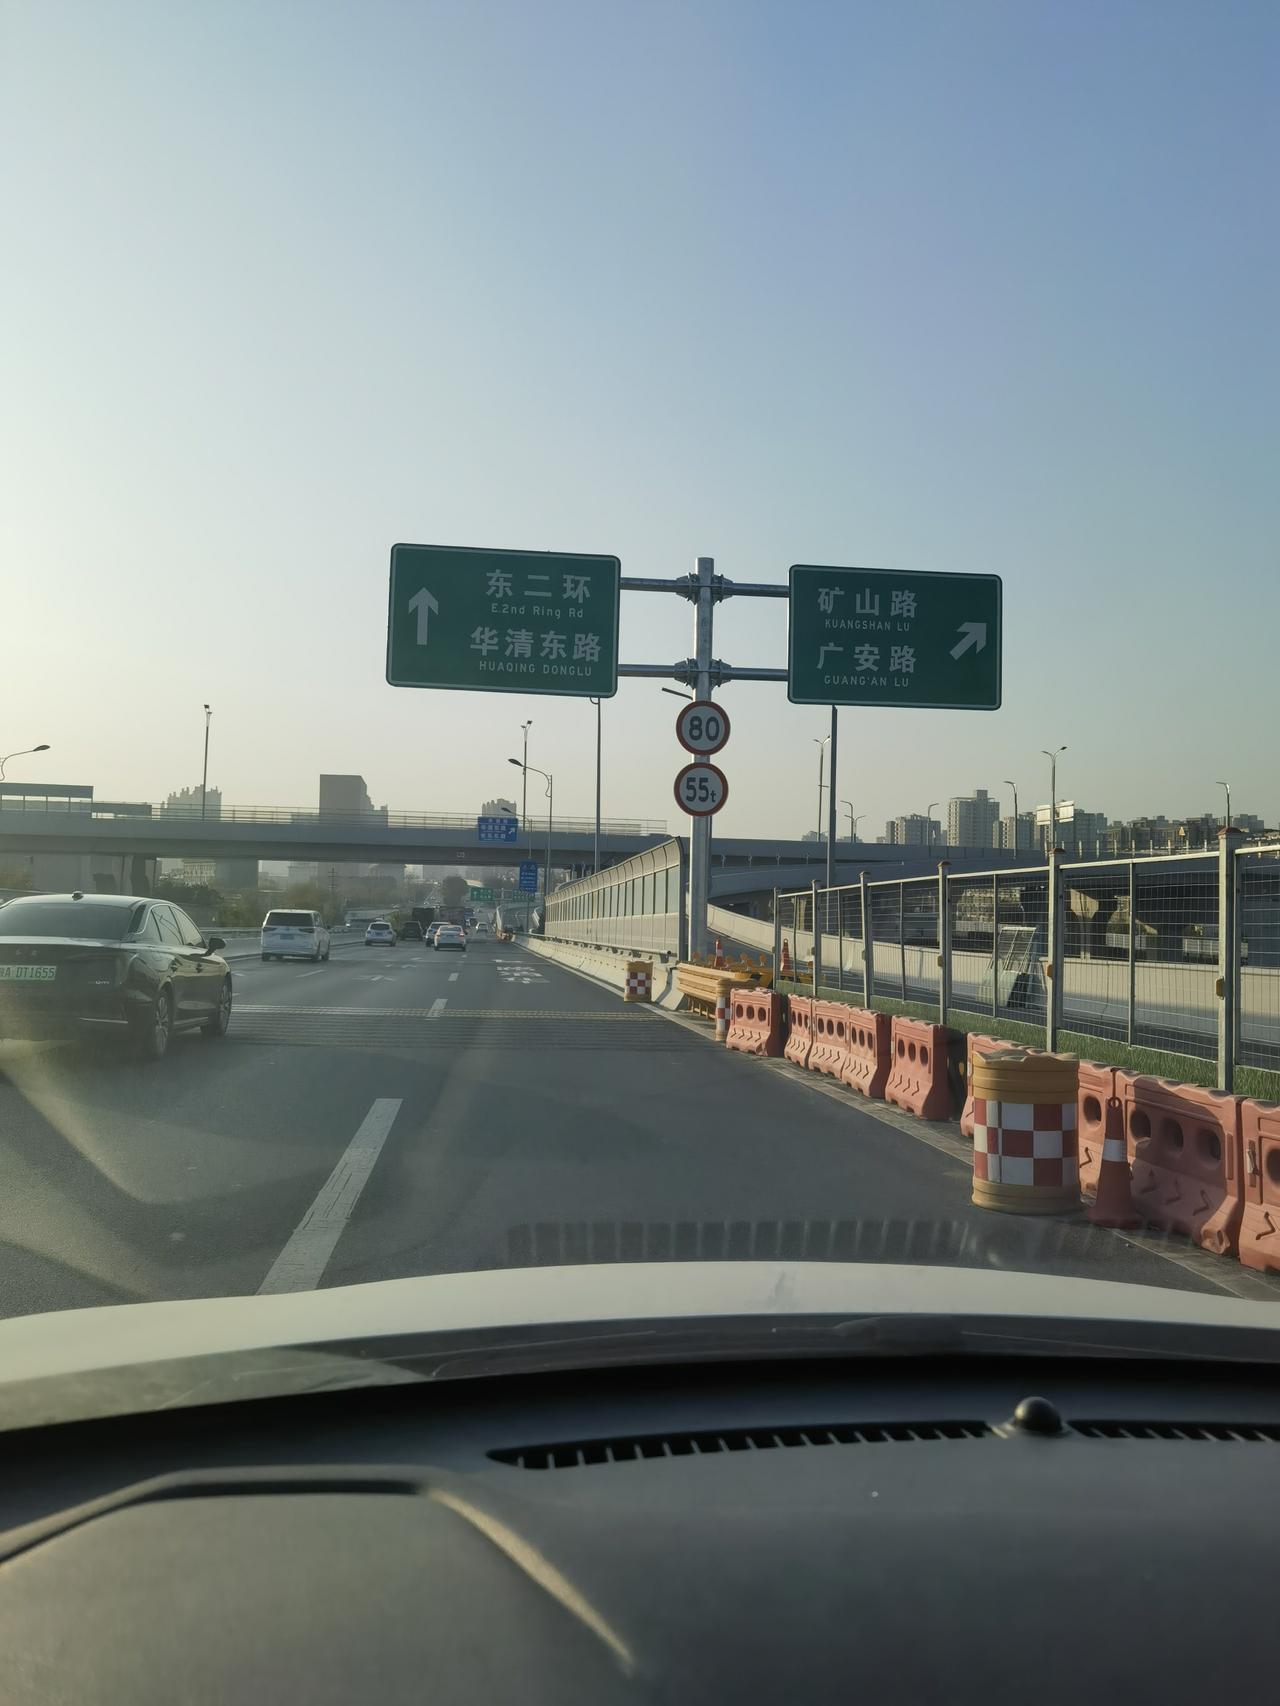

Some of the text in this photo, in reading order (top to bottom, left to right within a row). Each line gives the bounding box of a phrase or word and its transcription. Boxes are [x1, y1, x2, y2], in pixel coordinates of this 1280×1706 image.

[486, 569, 591, 603] 东二环
[533, 606, 561, 619] Ring
[569, 608, 584, 618] Rd
[817, 587, 917, 618] 矿山路
[825, 619, 910, 631] KUANGSHAN LU
[470, 626, 602, 662] 华清东路
[479, 661, 592, 677] HUAQING DONGLU
[816, 642, 917, 673] 广安路
[824, 675, 909, 687] GUANG'AN LU
[688, 716, 720, 741] 80
